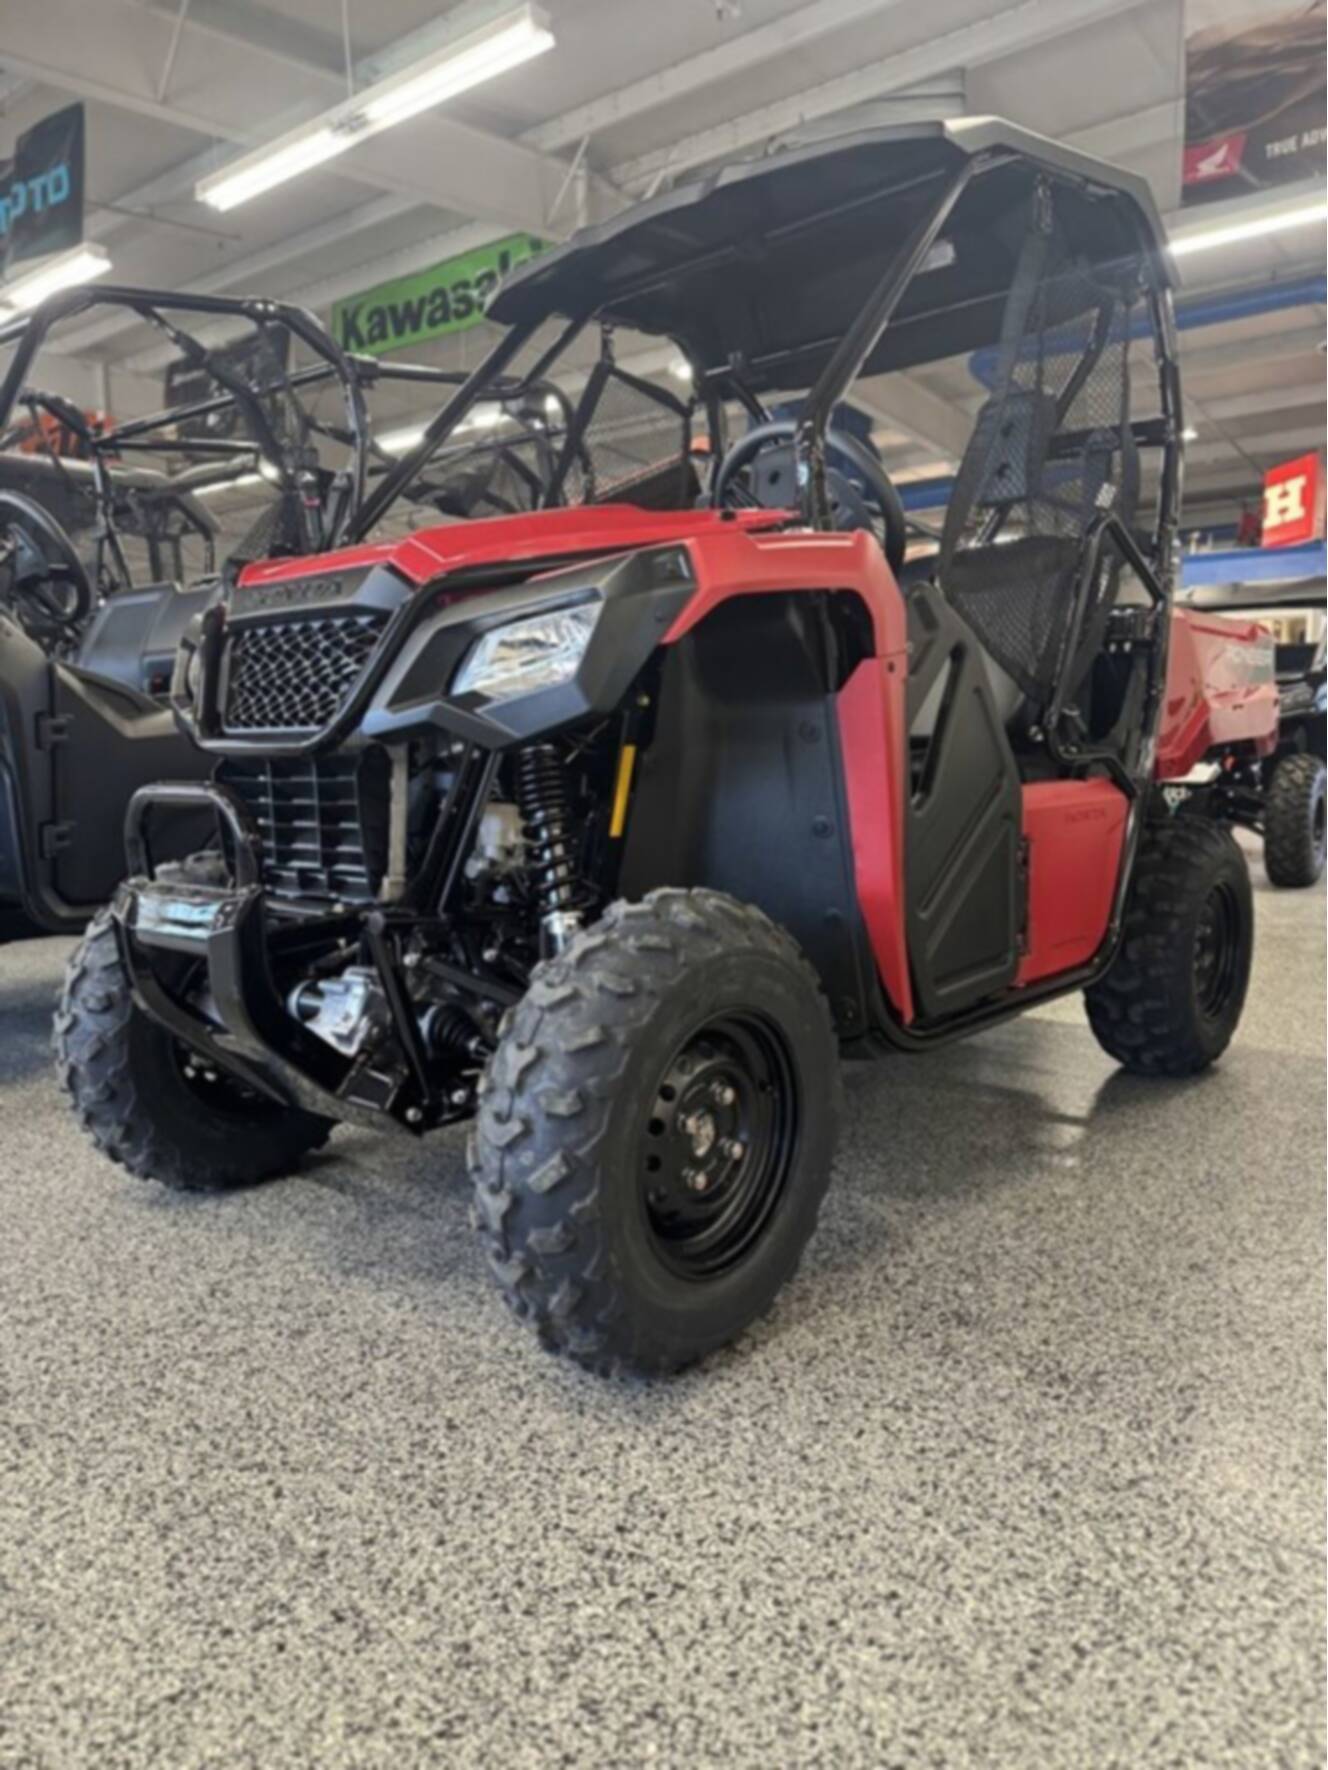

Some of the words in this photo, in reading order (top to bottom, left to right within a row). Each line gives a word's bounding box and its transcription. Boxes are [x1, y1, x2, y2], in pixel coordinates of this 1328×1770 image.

[1265, 134, 1297, 159] TRUE
[340, 237, 543, 352] Kawasa
[1263, 474, 1307, 530] H
